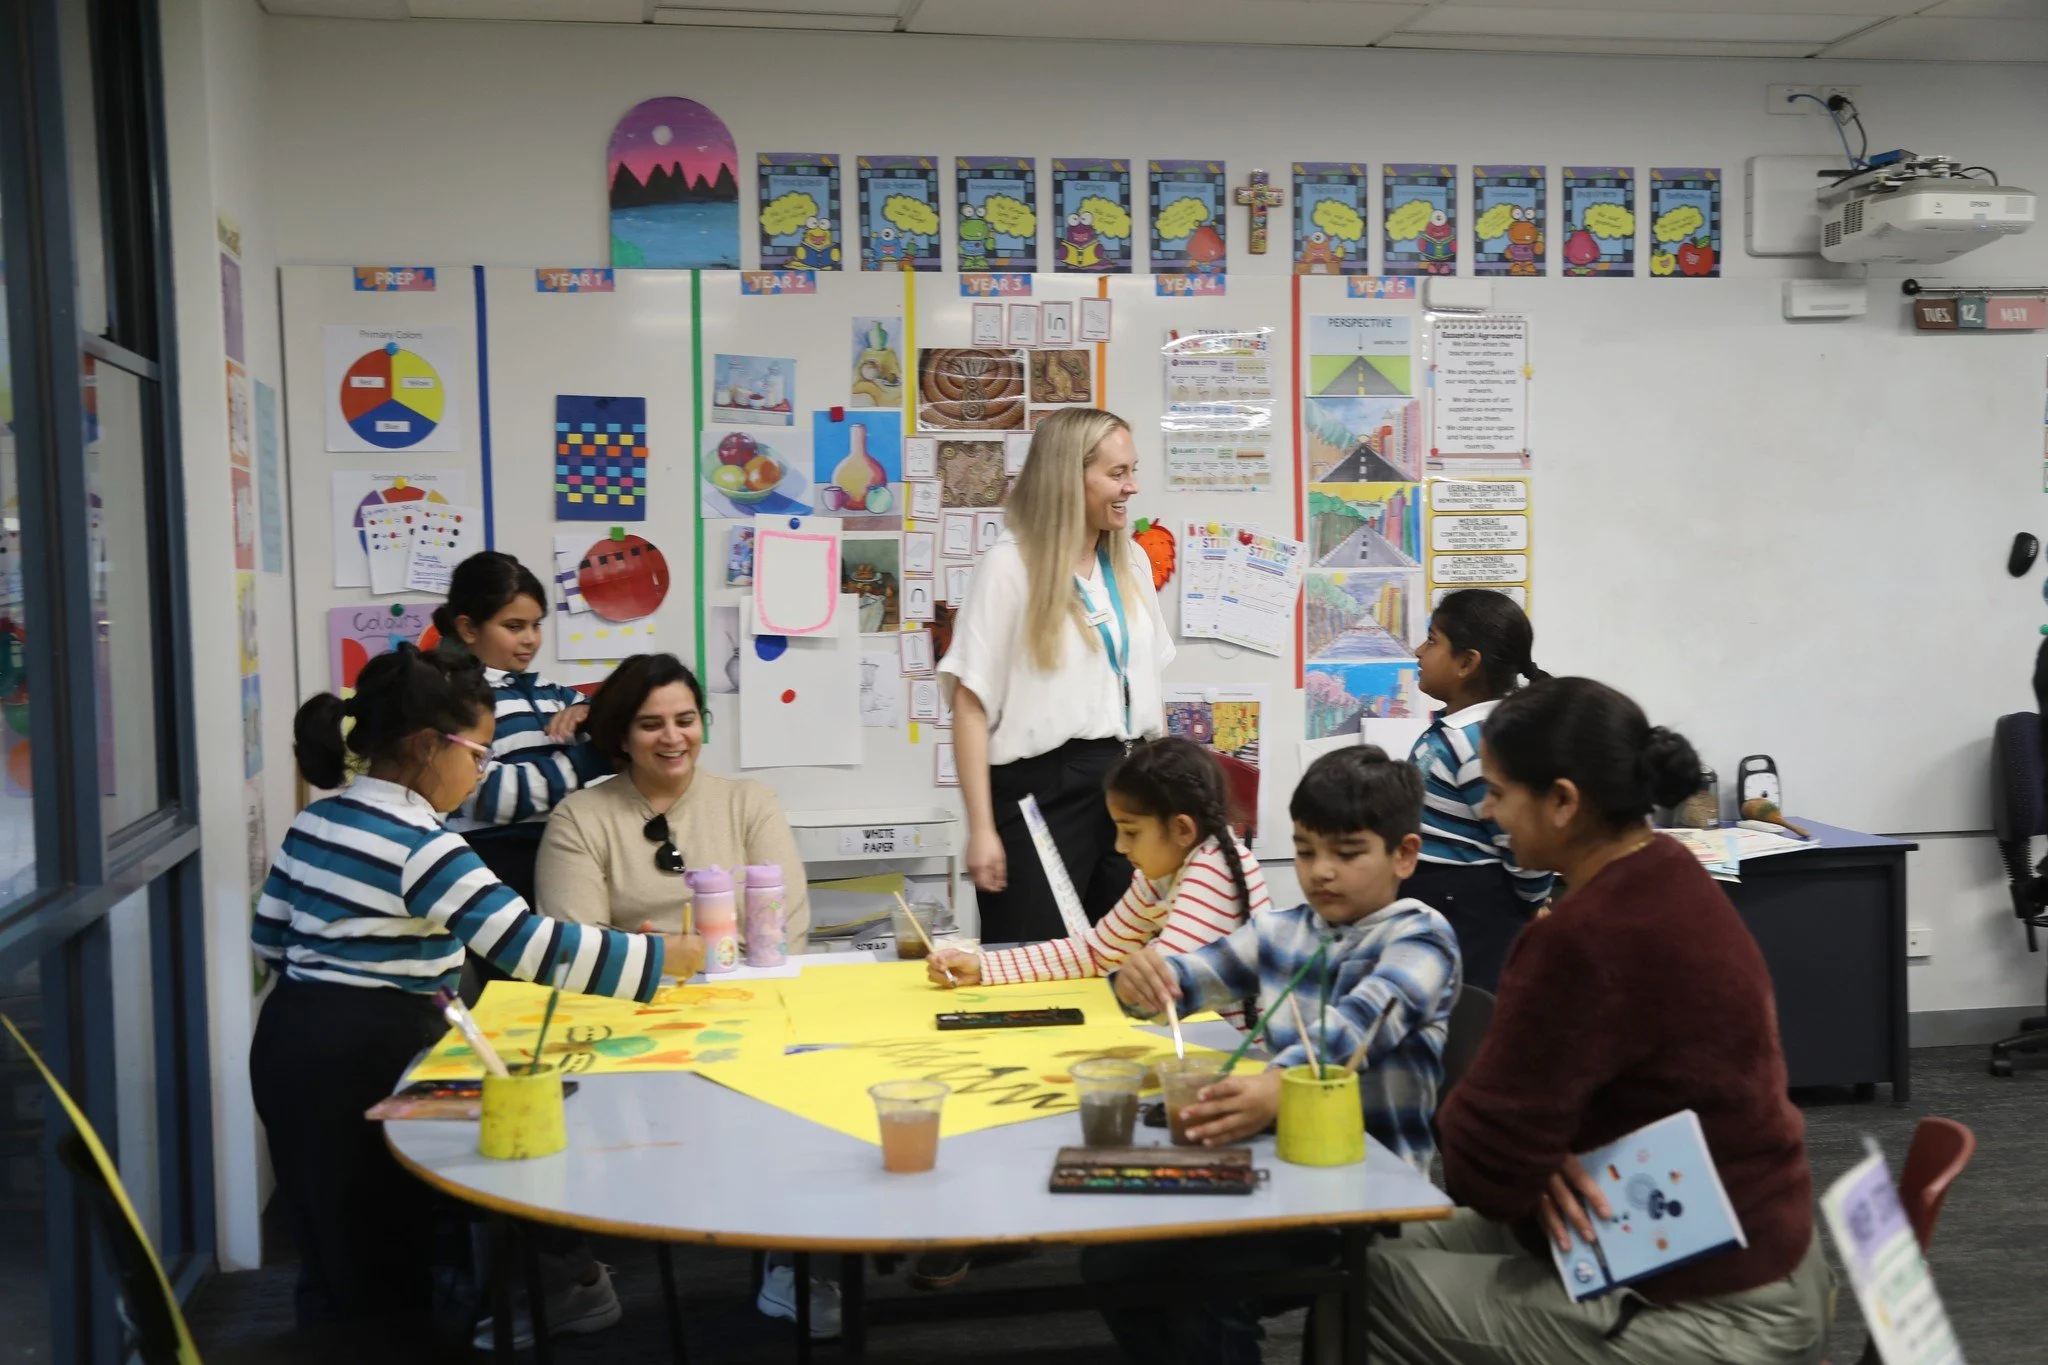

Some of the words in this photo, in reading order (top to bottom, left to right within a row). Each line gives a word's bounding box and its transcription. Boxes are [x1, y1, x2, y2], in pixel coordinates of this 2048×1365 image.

[375, 272, 415, 285] PREP
[549, 273, 591, 286] YEAR
[594, 273, 602, 286] 1
[752, 274, 793, 288] YEAR
[796, 274, 805, 287] 2
[970, 278, 1010, 290] YEAR
[1013, 278, 1022, 290] 3
[1166, 278, 1203, 291] YEAR
[1205, 278, 1216, 290] 4
[1358, 280, 1394, 292] YEAR
[1397, 280, 1406, 292] 5
[2001, 307, 2028, 321] MAY
[1328, 318, 1392, 328] PERSPECTIVE
[395, 330, 423, 339] Colors
[353, 612, 422, 632] Colours
[862, 828, 895, 839] WHITE
[863, 842, 896, 853] PAPER
